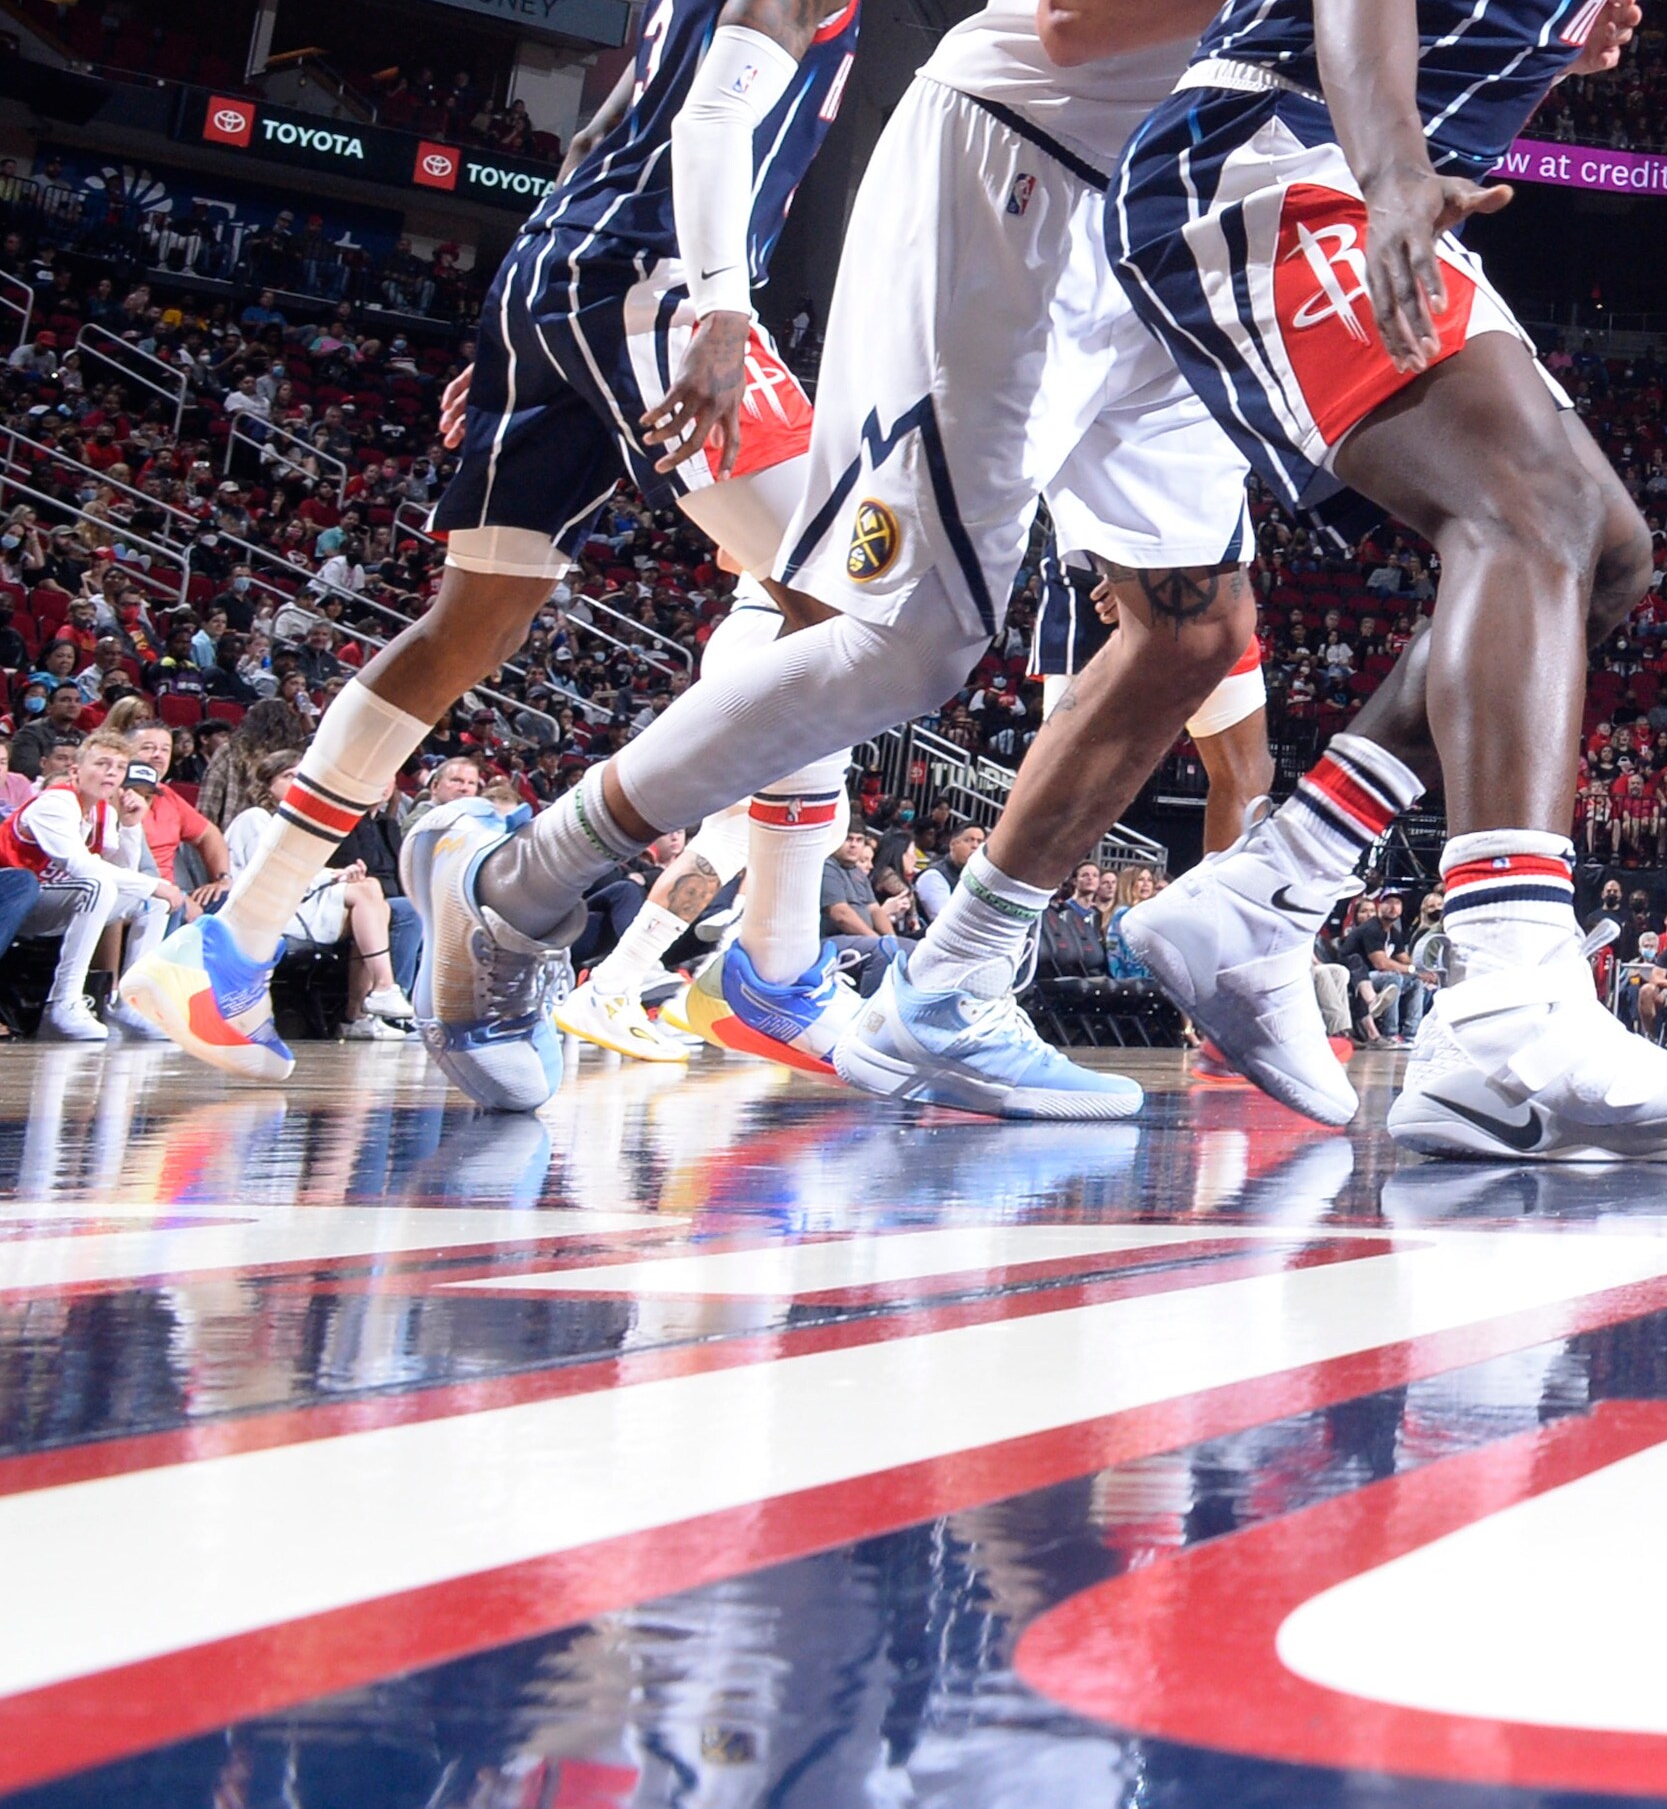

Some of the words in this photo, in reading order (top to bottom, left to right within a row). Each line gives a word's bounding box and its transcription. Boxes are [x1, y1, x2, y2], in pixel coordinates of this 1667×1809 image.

[261, 118, 364, 159] TOYOTA
[466, 162, 558, 199] TOYOTA
[1539, 154, 1571, 179] at
